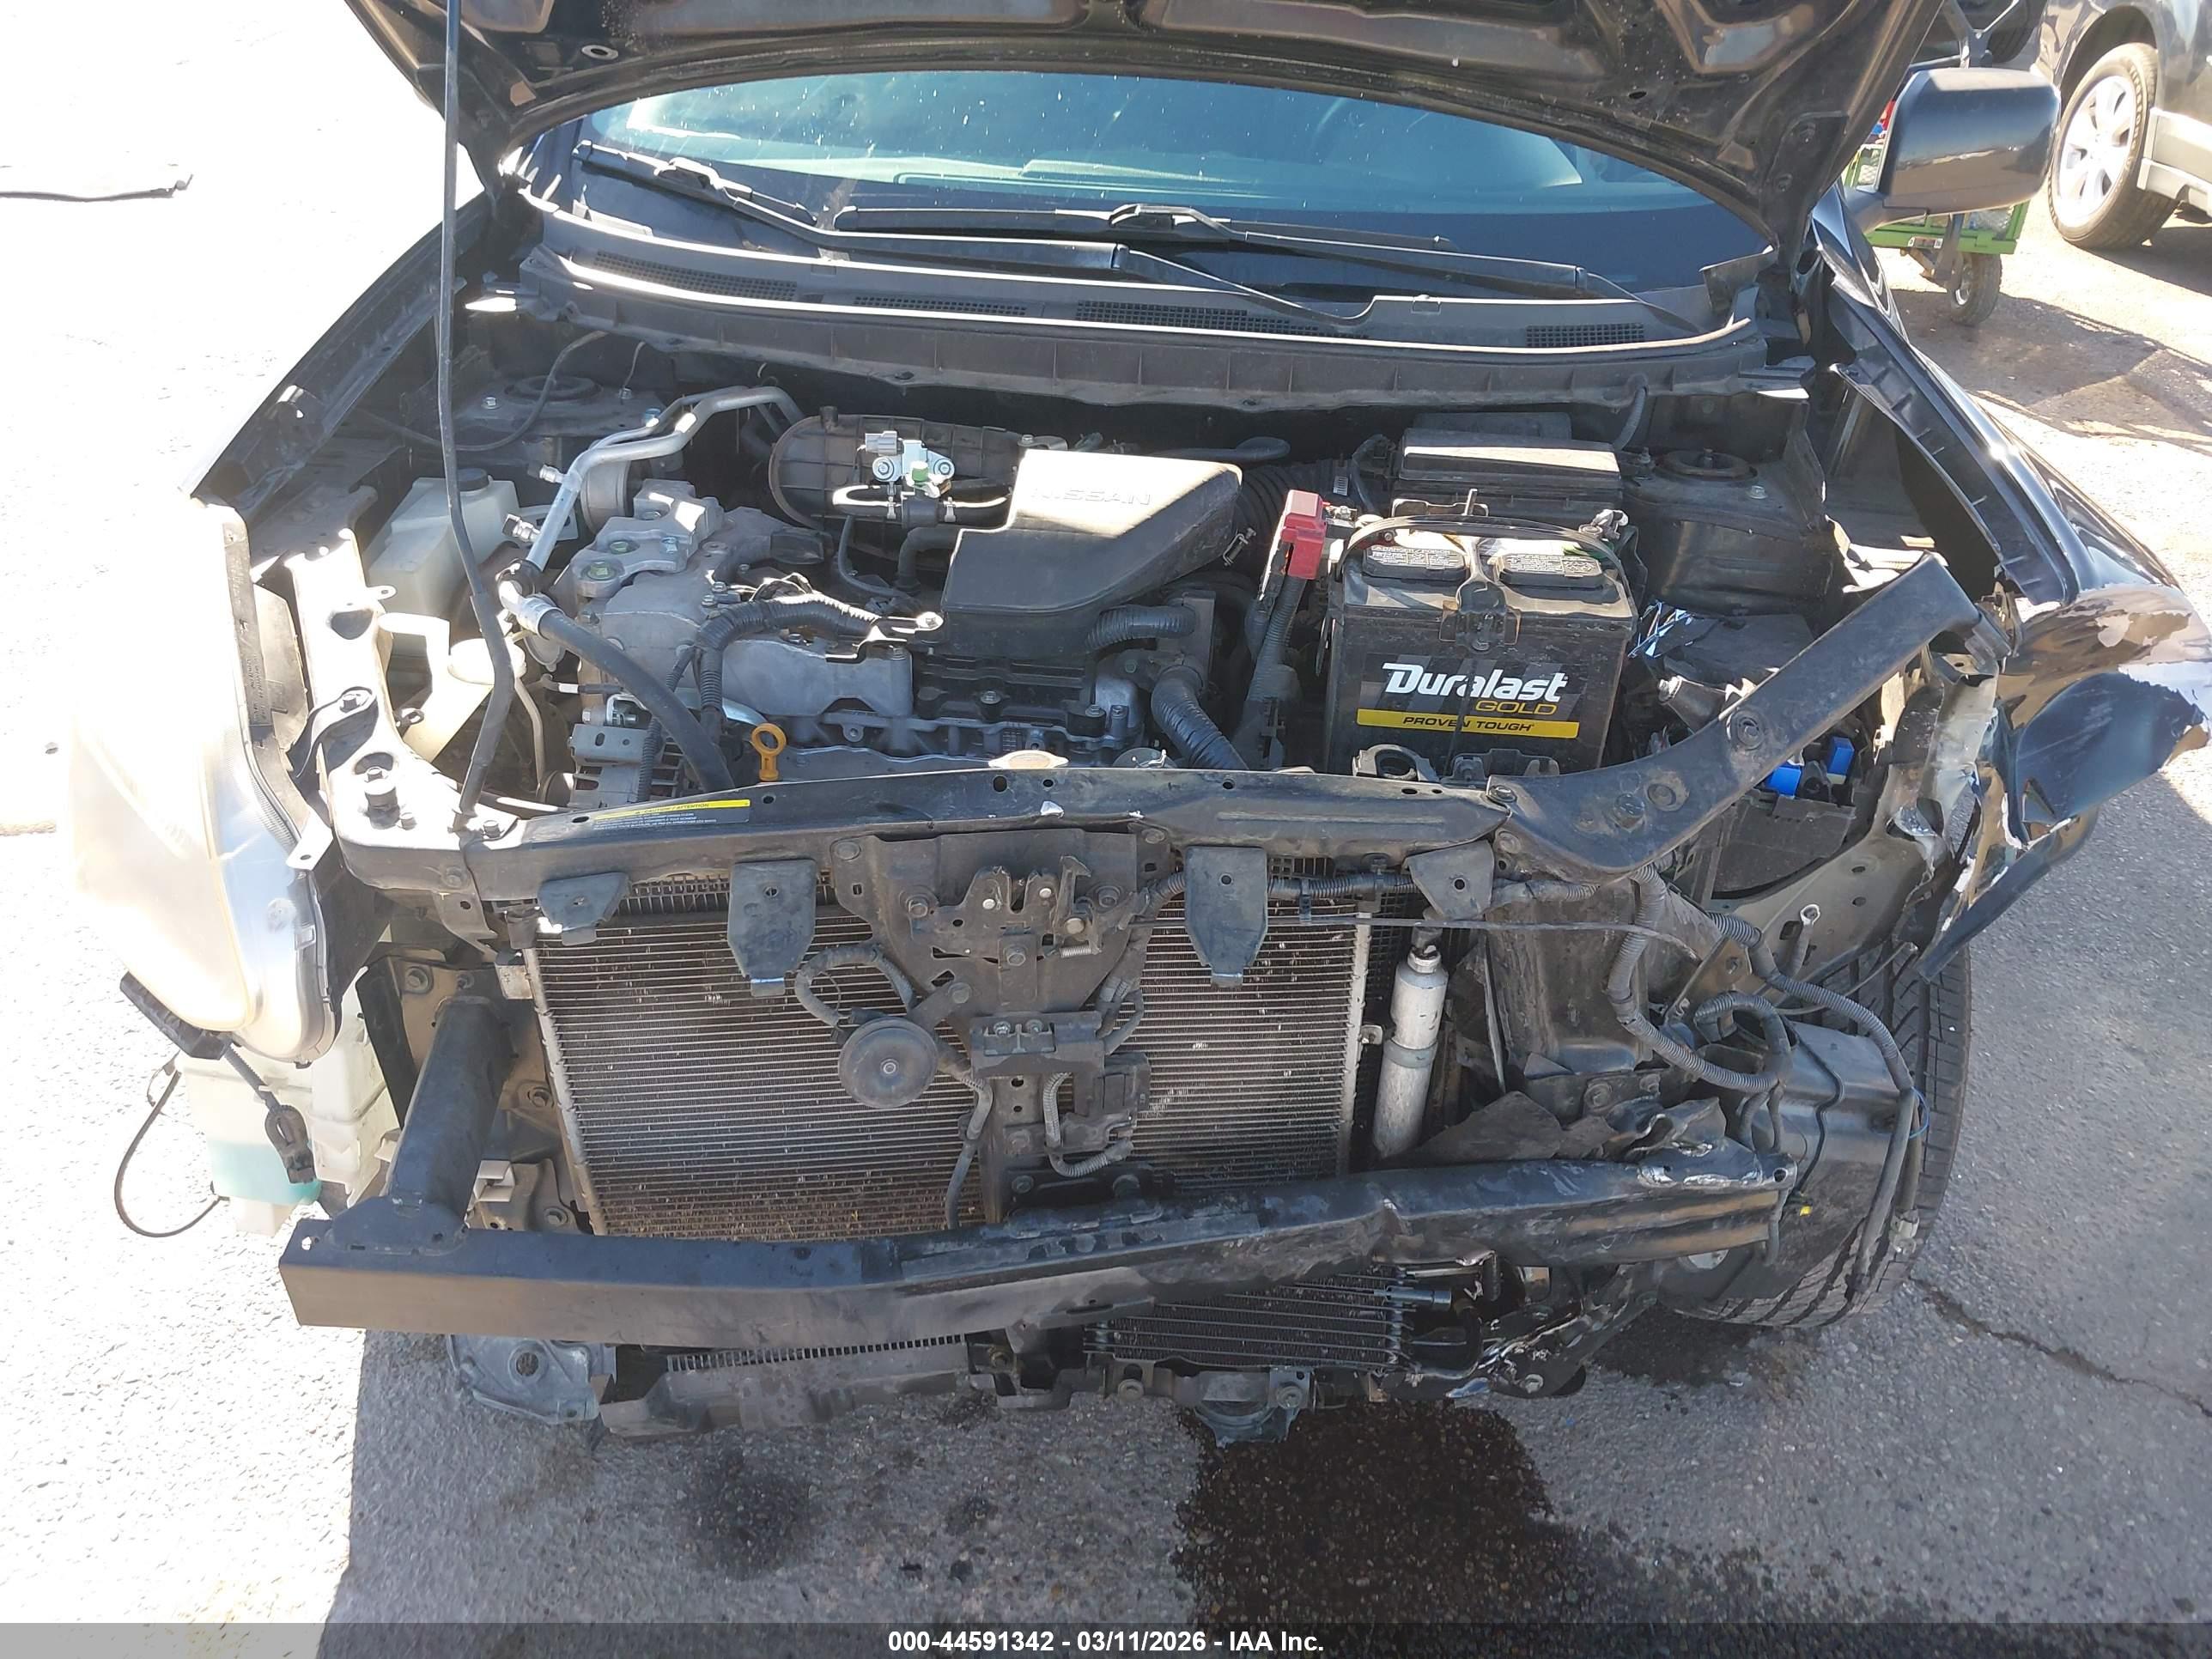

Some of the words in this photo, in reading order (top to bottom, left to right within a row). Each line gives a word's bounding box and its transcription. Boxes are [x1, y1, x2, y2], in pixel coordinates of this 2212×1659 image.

[1030, 487, 1152, 506] NISSAN
[1382, 662, 1568, 702] Duralast
[1475, 700, 1558, 716] GOLD
[1402, 716, 1471, 728] PROVEN
[1476, 720, 1534, 732] TOUGH
